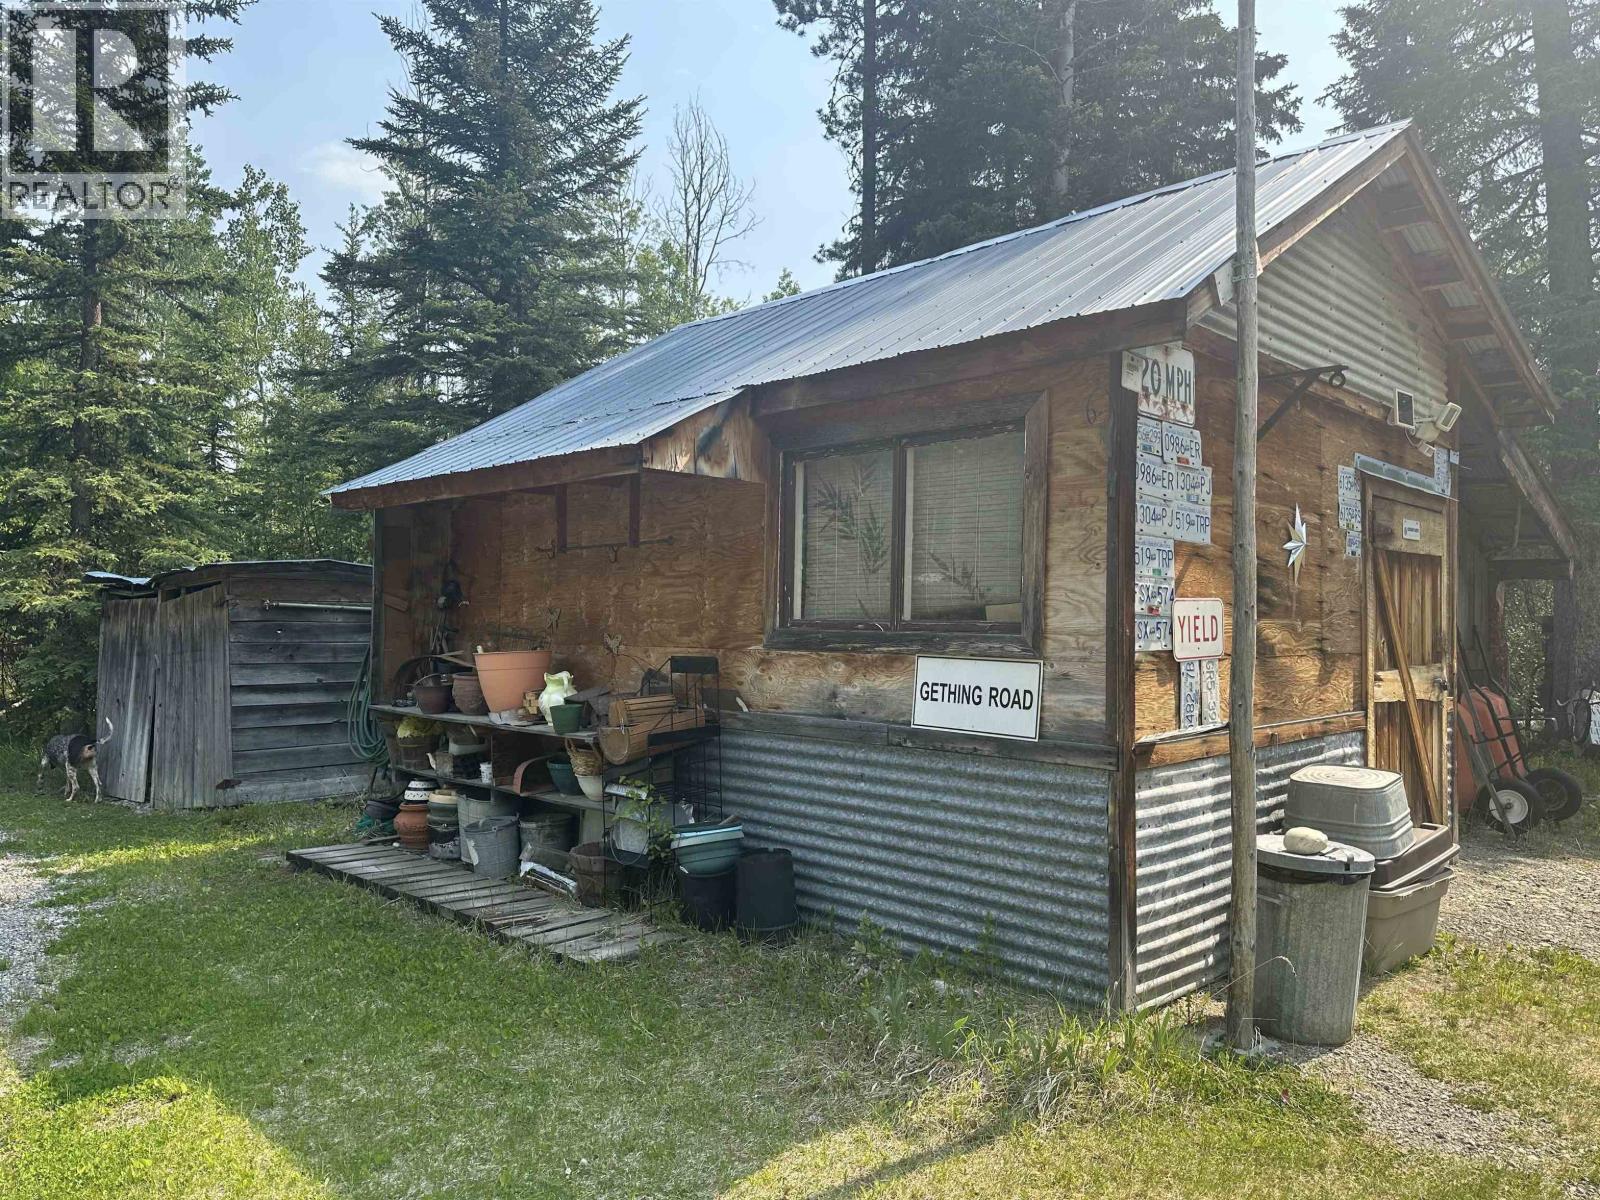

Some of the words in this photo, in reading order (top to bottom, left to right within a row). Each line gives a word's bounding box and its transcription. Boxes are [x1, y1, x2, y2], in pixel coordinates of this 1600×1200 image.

[1166, 363, 1191, 405] MPH
[1165, 433, 1185, 455] 0986
[1175, 511, 1191, 532] 519
[1195, 514, 1210, 534] TRP
[1156, 548, 1173, 568] TRP
[1178, 616, 1218, 643] YIELD
[920, 682, 982, 706] GETHING
[988, 686, 1034, 710] ROAD
